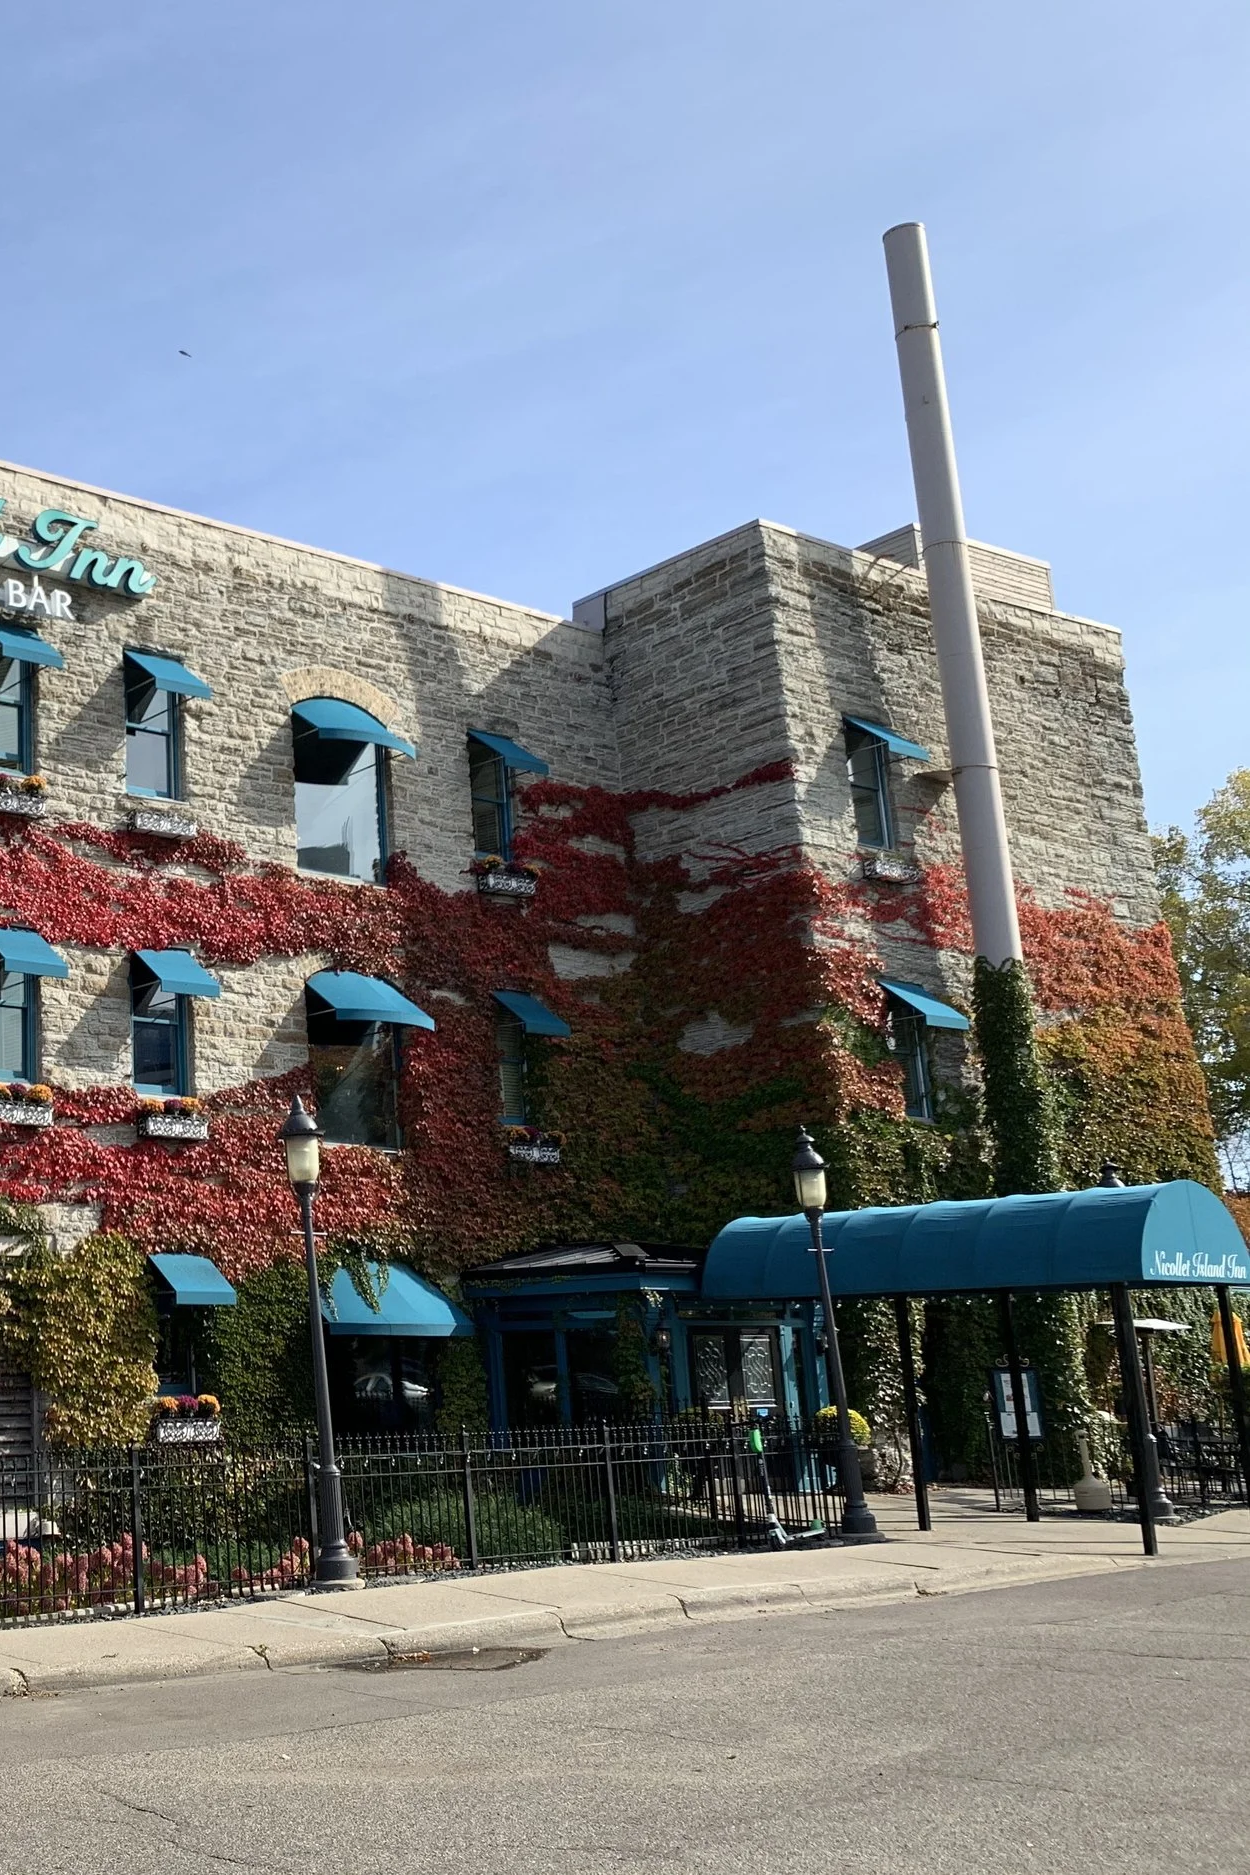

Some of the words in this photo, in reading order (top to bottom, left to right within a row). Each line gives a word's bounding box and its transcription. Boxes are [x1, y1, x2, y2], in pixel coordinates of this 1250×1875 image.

[15, 509, 156, 595] Inn
[5, 579, 76, 620] BAR
[1150, 1250, 1190, 1276] Nicollet
[1192, 1252, 1225, 1278] Island
[1227, 1254, 1247, 1279] Inn
